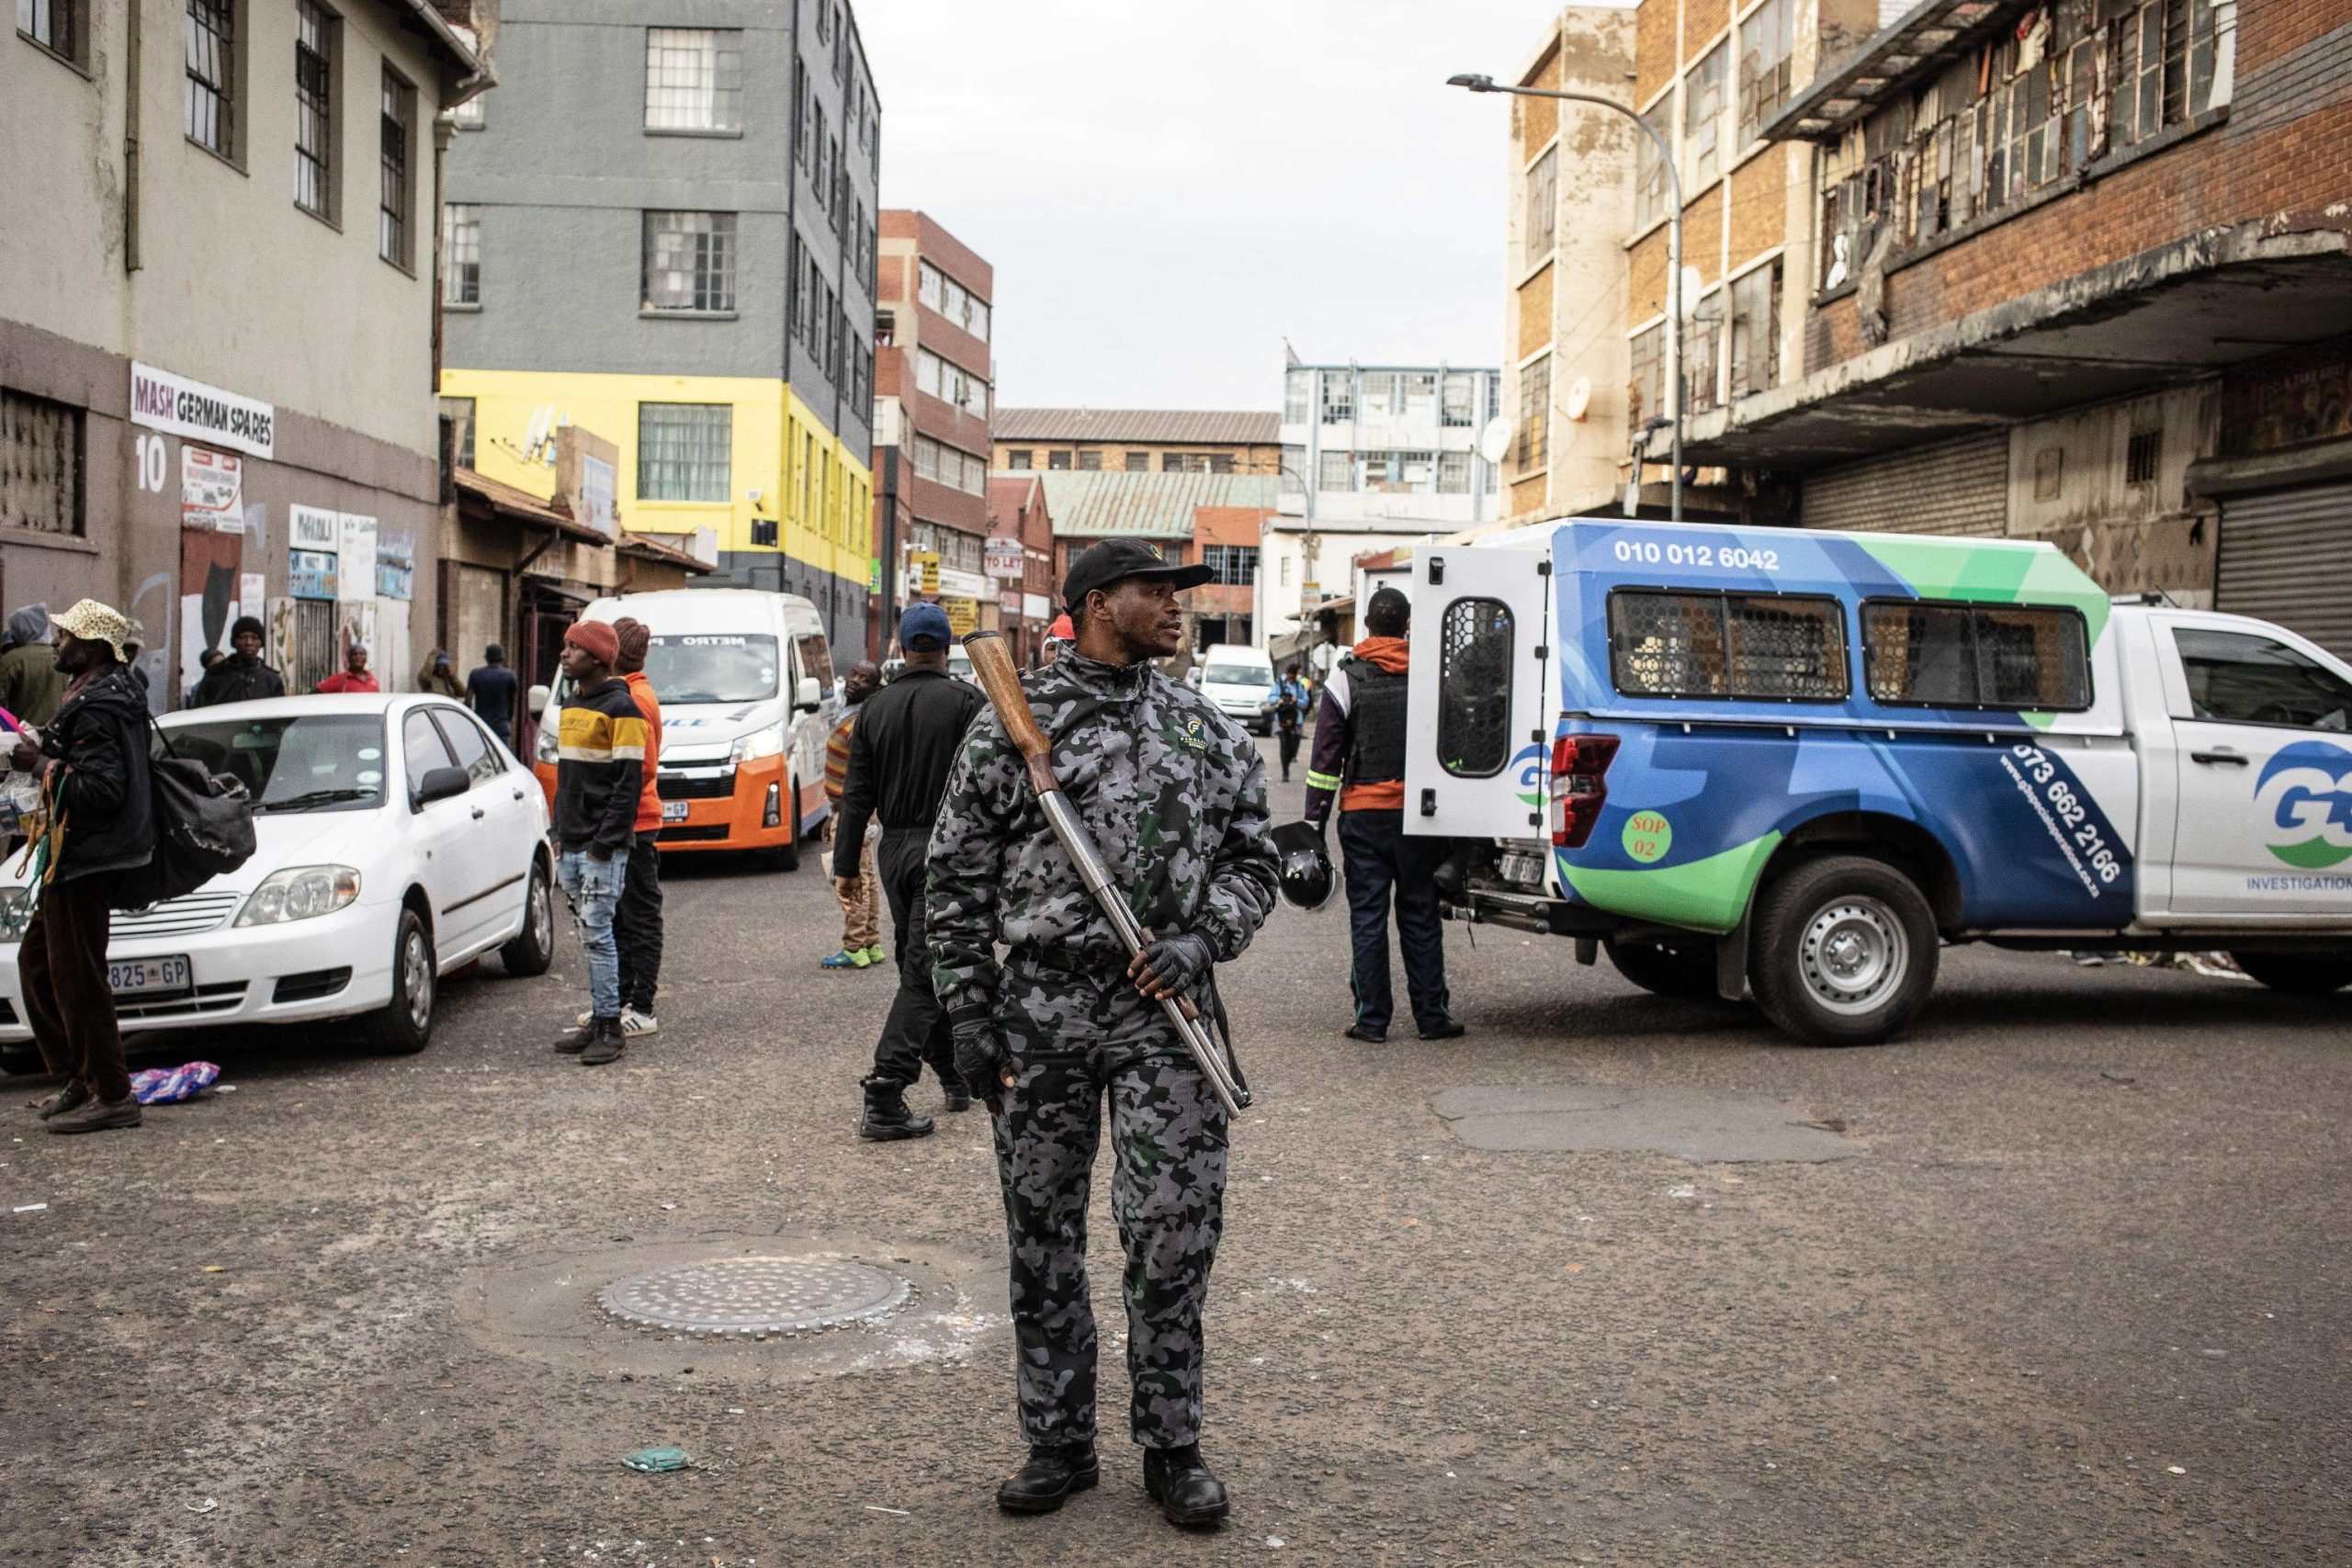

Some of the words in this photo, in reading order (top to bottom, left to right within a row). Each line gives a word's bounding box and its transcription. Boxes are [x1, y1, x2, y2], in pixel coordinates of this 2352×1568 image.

[135, 376, 175, 420] MASH
[177, 391, 228, 432] GERMAN
[231, 408, 271, 446] SPARES
[136, 434, 166, 493] 10
[986, 556, 1000, 568] TO
[1003, 557, 1021, 568] LET
[1614, 540, 1661, 563] 010
[1667, 544, 1713, 567] 012
[1718, 547, 1780, 571] 6042
[1632, 816, 1667, 834] SOP
[2012, 744, 2054, 784] 073
[2048, 781, 2085, 829] 662
[2075, 824, 2120, 883] 2166
[1634, 840, 1655, 856] 02
[111, 964, 145, 988] 825
[162, 961, 185, 984] GP
